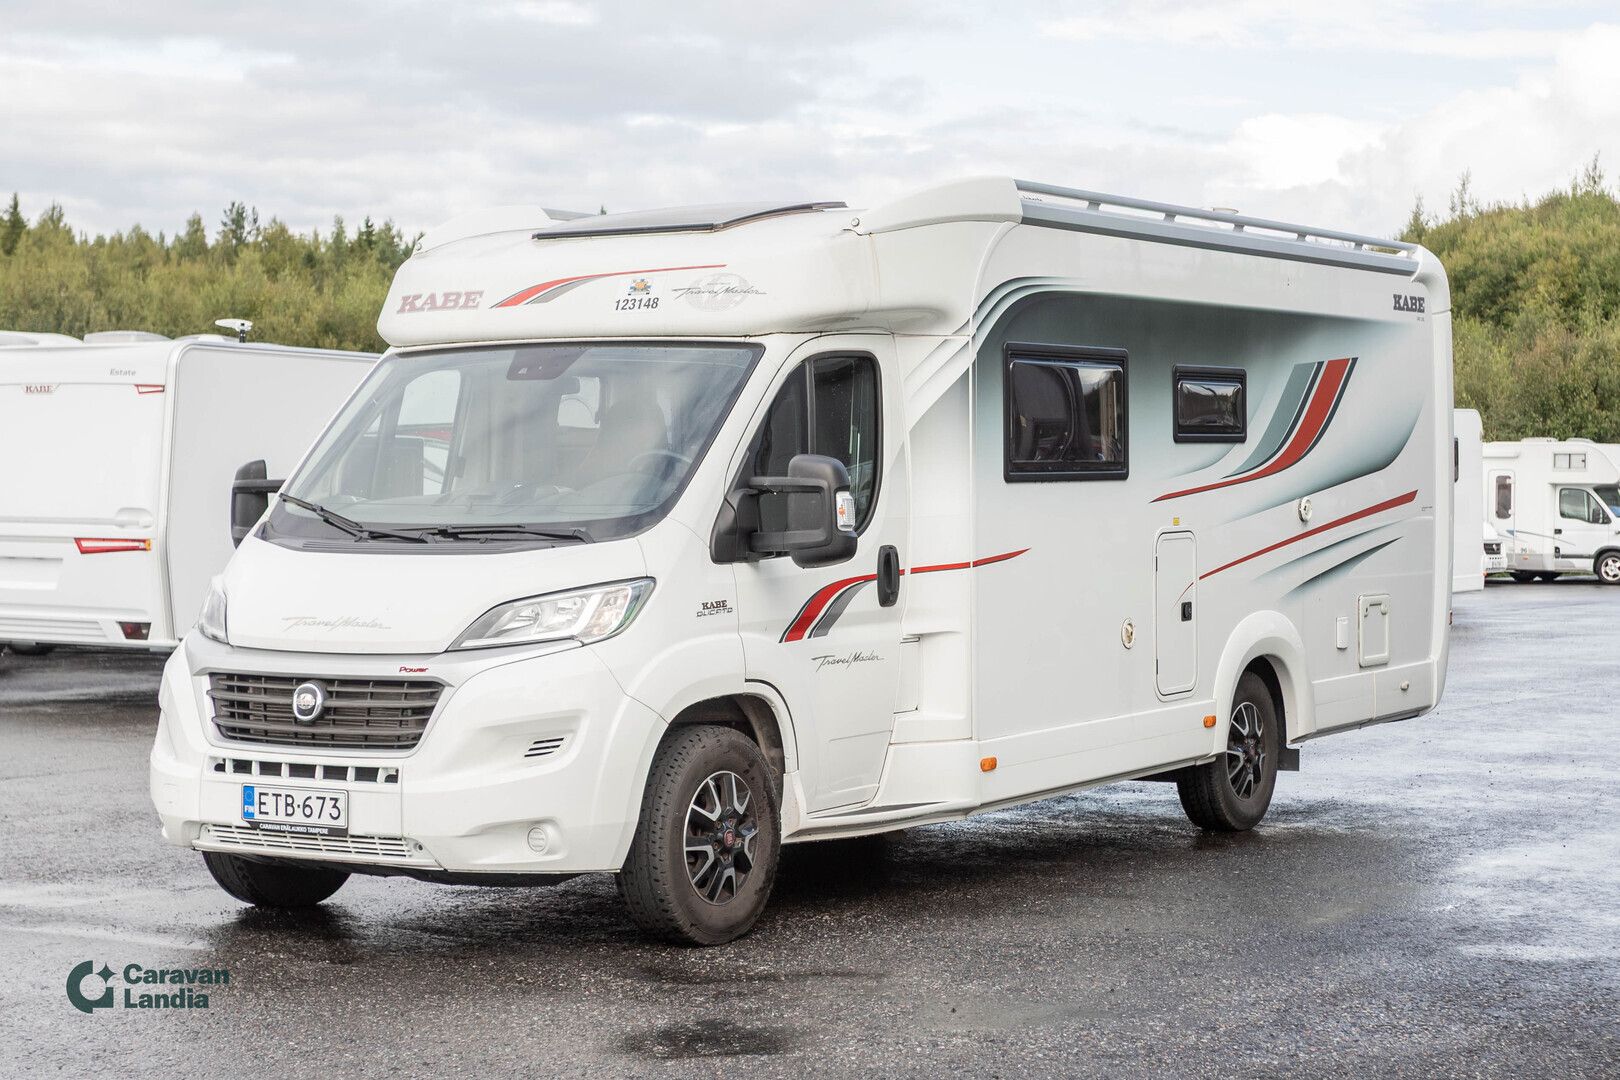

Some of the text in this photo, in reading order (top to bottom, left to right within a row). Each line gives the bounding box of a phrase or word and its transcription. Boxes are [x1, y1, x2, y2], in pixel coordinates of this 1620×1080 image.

[396, 290, 484, 314] KABE
[615, 297, 660, 311] 123148
[1392, 293, 1425, 313] KABE
[110, 368, 137, 377] Estate
[25, 385, 53, 393] KABE
[701, 599, 728, 610] KABE
[696, 607, 733, 617] DUCATO
[259, 823, 281, 831] CARAVAN
[307, 826, 329, 835] TAMPERE
